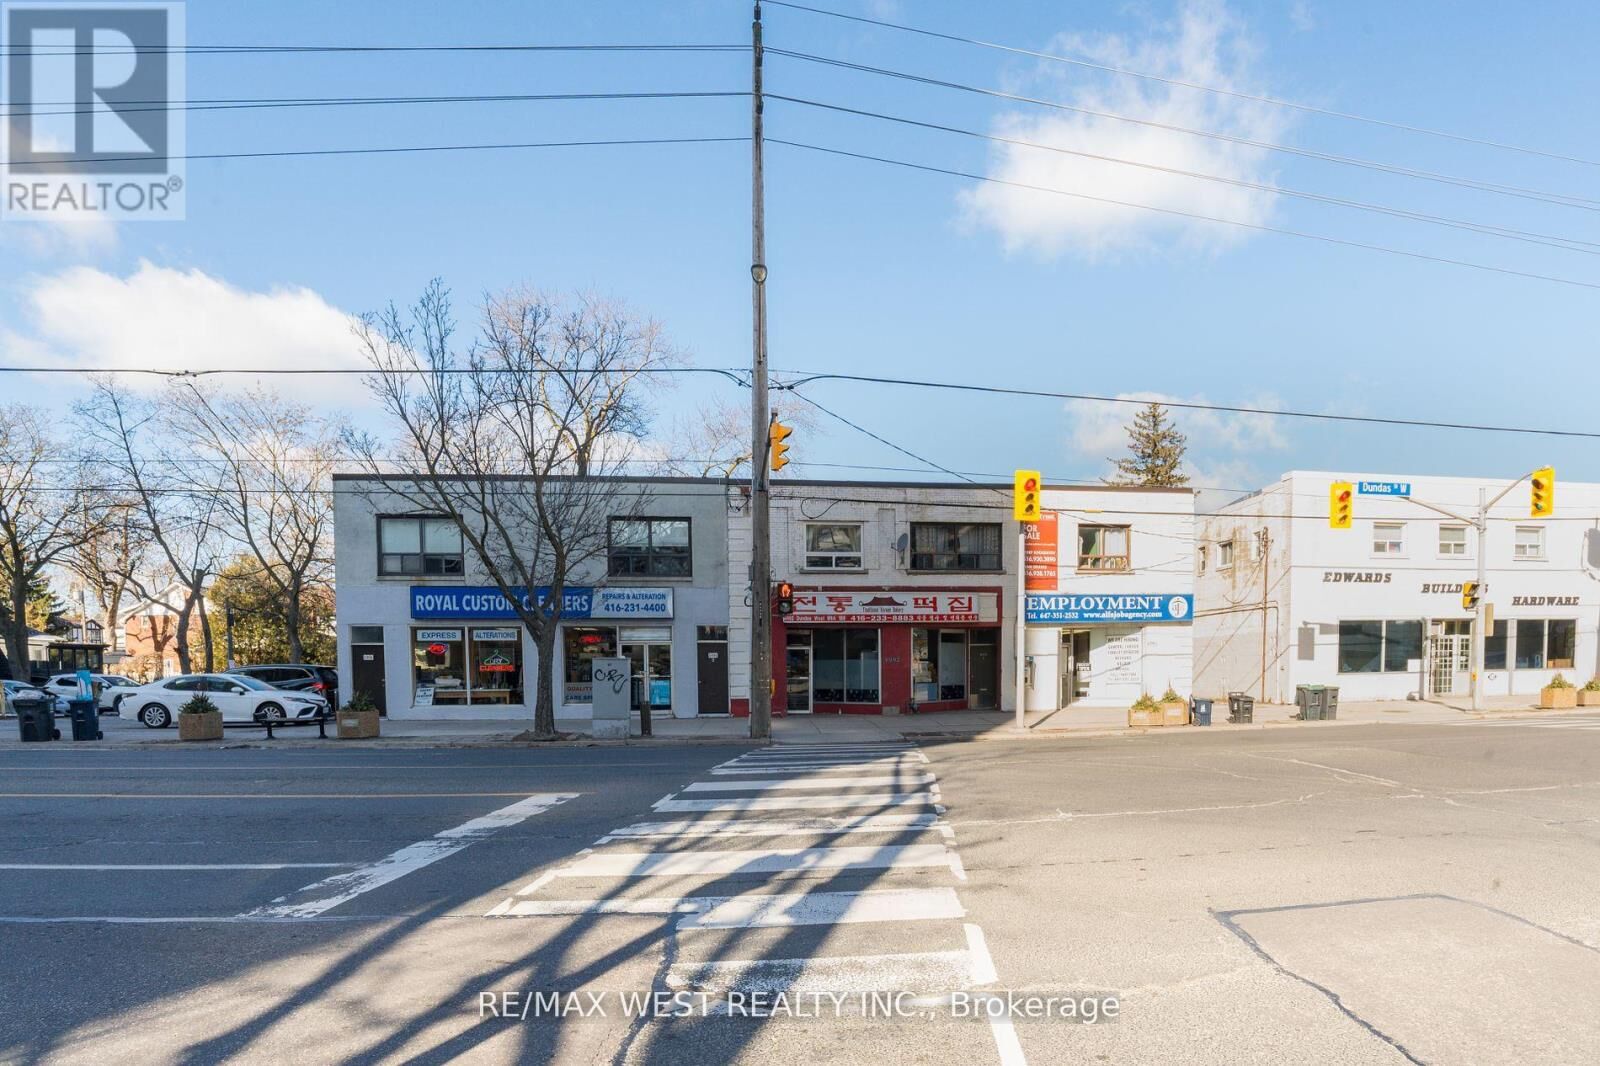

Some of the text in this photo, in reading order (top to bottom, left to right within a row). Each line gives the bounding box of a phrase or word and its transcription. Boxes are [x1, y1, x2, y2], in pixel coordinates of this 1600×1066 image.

[1362, 482, 1391, 493] Dundas
[1400, 483, 1407, 493] W
[1323, 572, 1392, 583] EDWARDS
[602, 592, 625, 600] REPAIRS
[1512, 596, 1580, 606] HARDWARE
[415, 595, 459, 611] ROYAL
[604, 603, 666, 612] 416-231-4400
[1026, 596, 1164, 610] EMPLOYMENT
